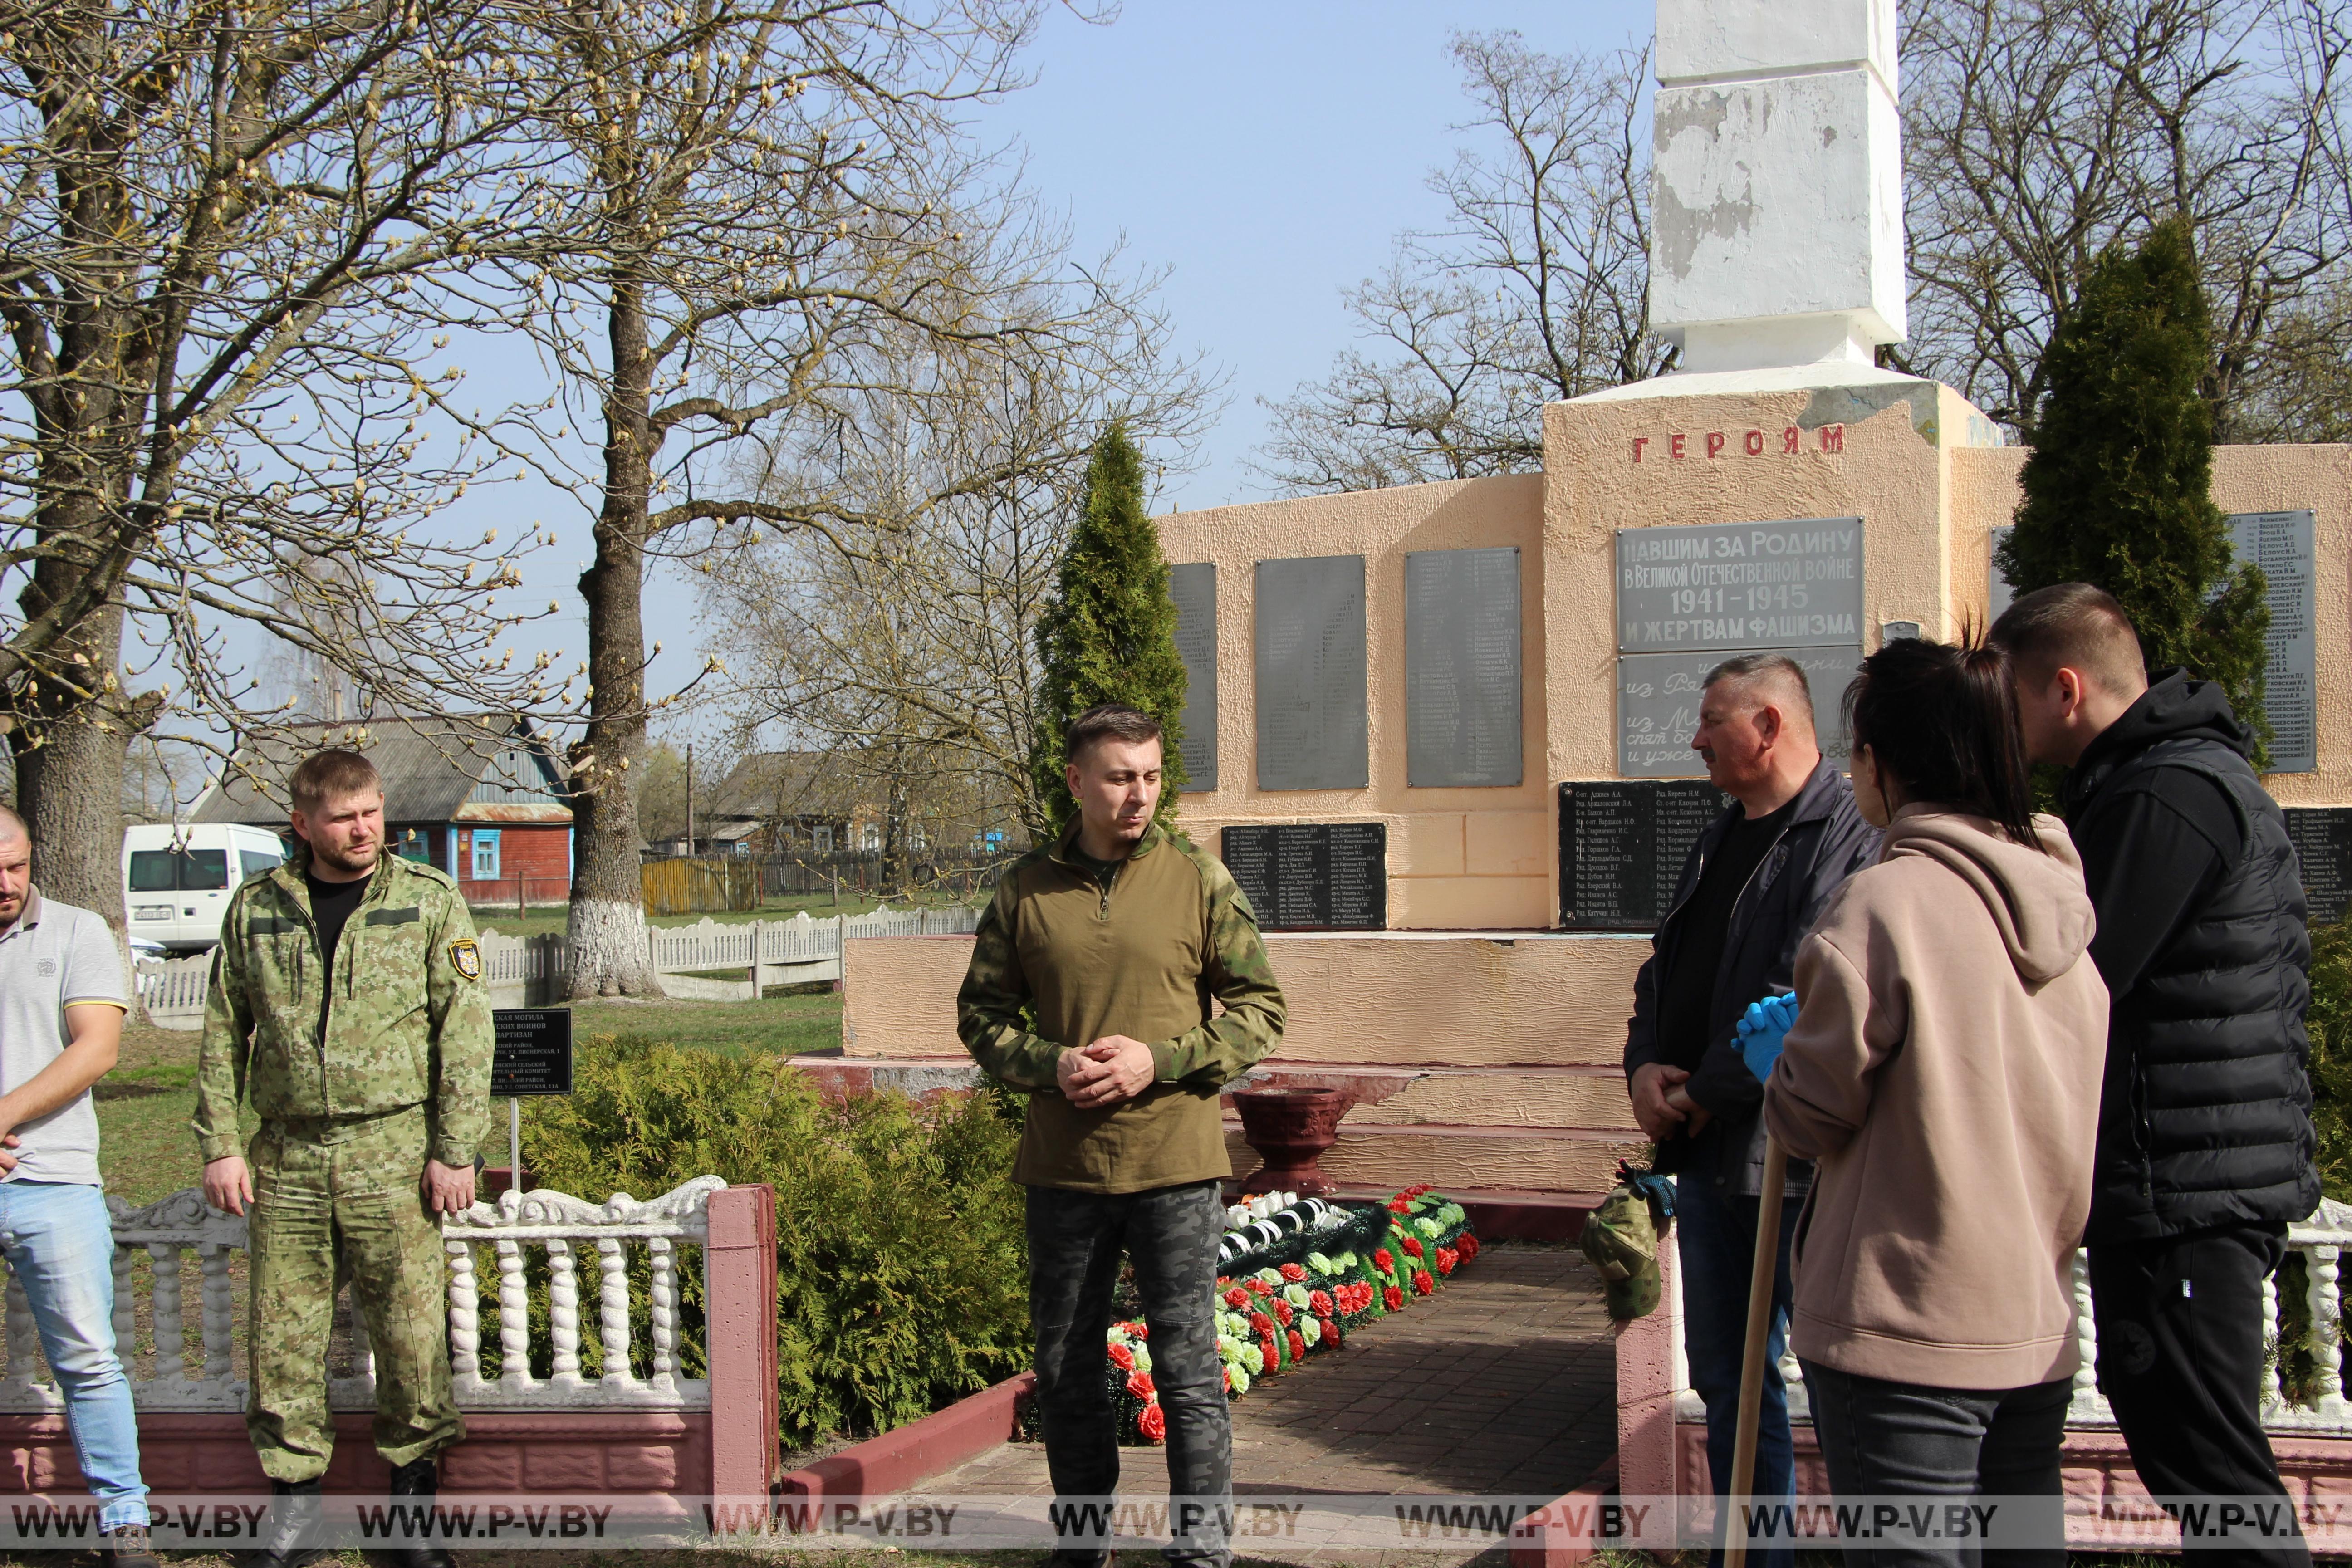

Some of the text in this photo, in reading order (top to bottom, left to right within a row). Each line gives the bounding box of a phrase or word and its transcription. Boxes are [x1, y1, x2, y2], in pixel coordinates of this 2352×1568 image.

[1635, 425, 1843, 462] ГЕРОЯМ
[1624, 530, 1854, 562] ПАВШИМ ЗА РОДИНУ
[1635, 563, 1688, 588] ВЕЛИКОЙ
[1691, 557, 1800, 585] ОТЕЧЕСТВЕННОЙ
[1805, 556, 1854, 581] ВОЙНЕ
[1626, 614, 1855, 642] И ЖЕРТВАМ ФАШИЗМА
[1627, 673, 1706, 697] из Ря
[1627, 706, 1701, 732] из Мо
[1627, 729, 1695, 745] спят бо
[1628, 750, 1694, 766] и уже
